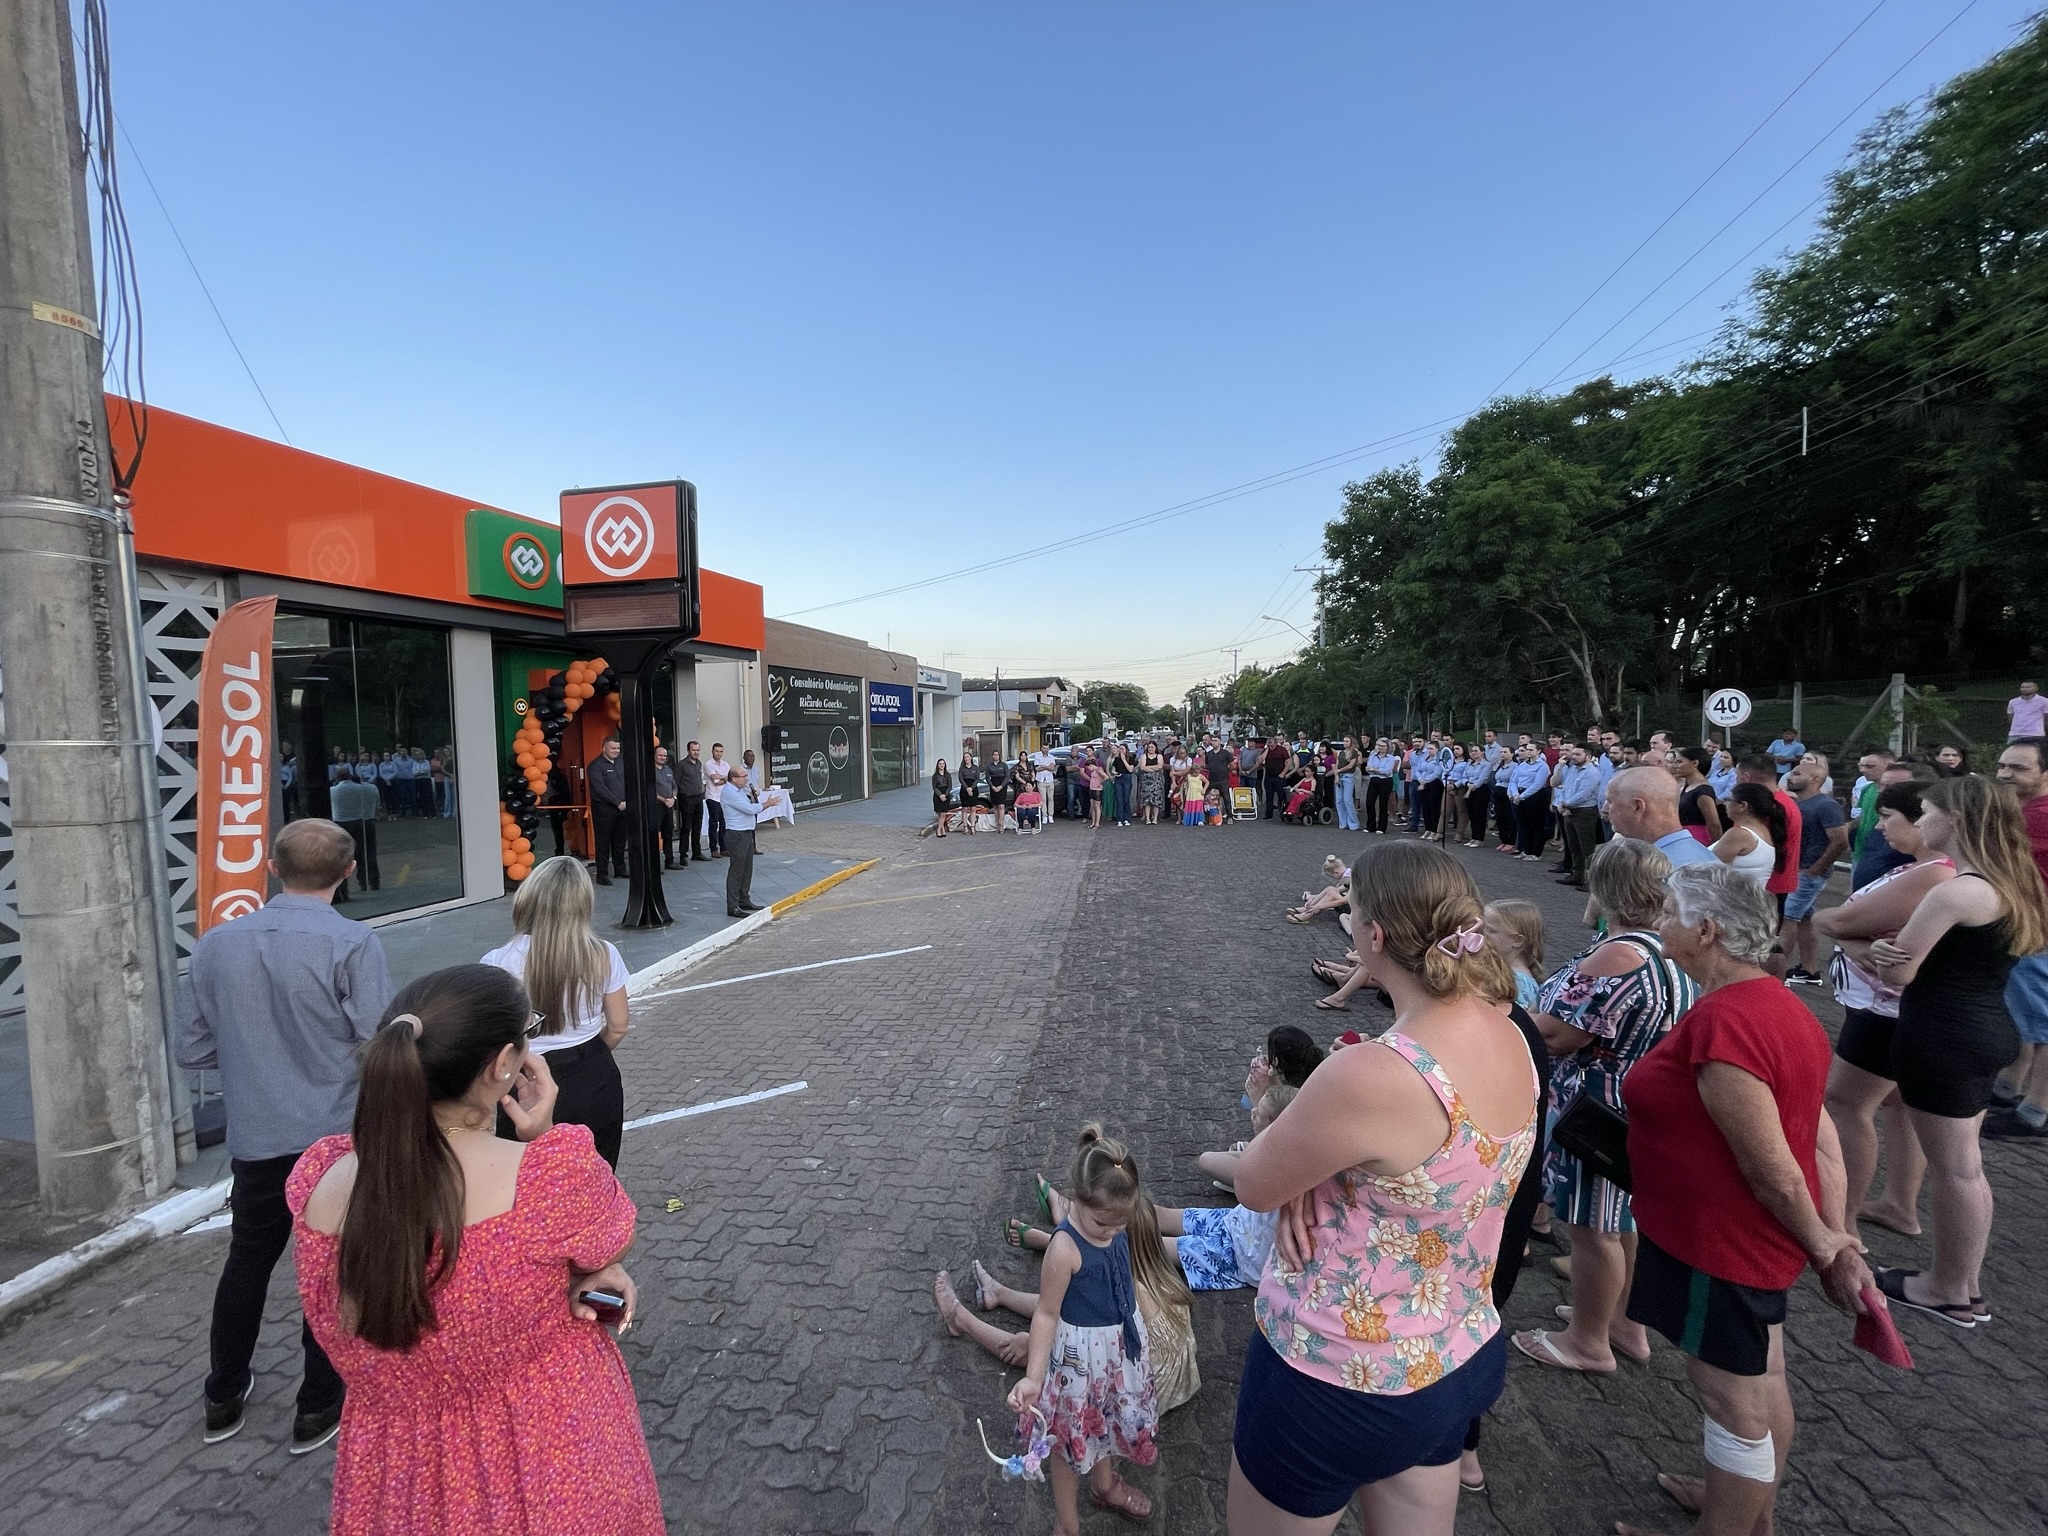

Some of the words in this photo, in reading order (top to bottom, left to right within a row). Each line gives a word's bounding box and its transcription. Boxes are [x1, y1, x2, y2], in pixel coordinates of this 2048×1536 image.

[790, 675, 824, 690] Consultório
[825, 679, 859, 694] Odontológico
[799, 697, 822, 708] Ricardo
[1713, 696, 1741, 714] 40
[215, 651, 263, 873] CRESOL
